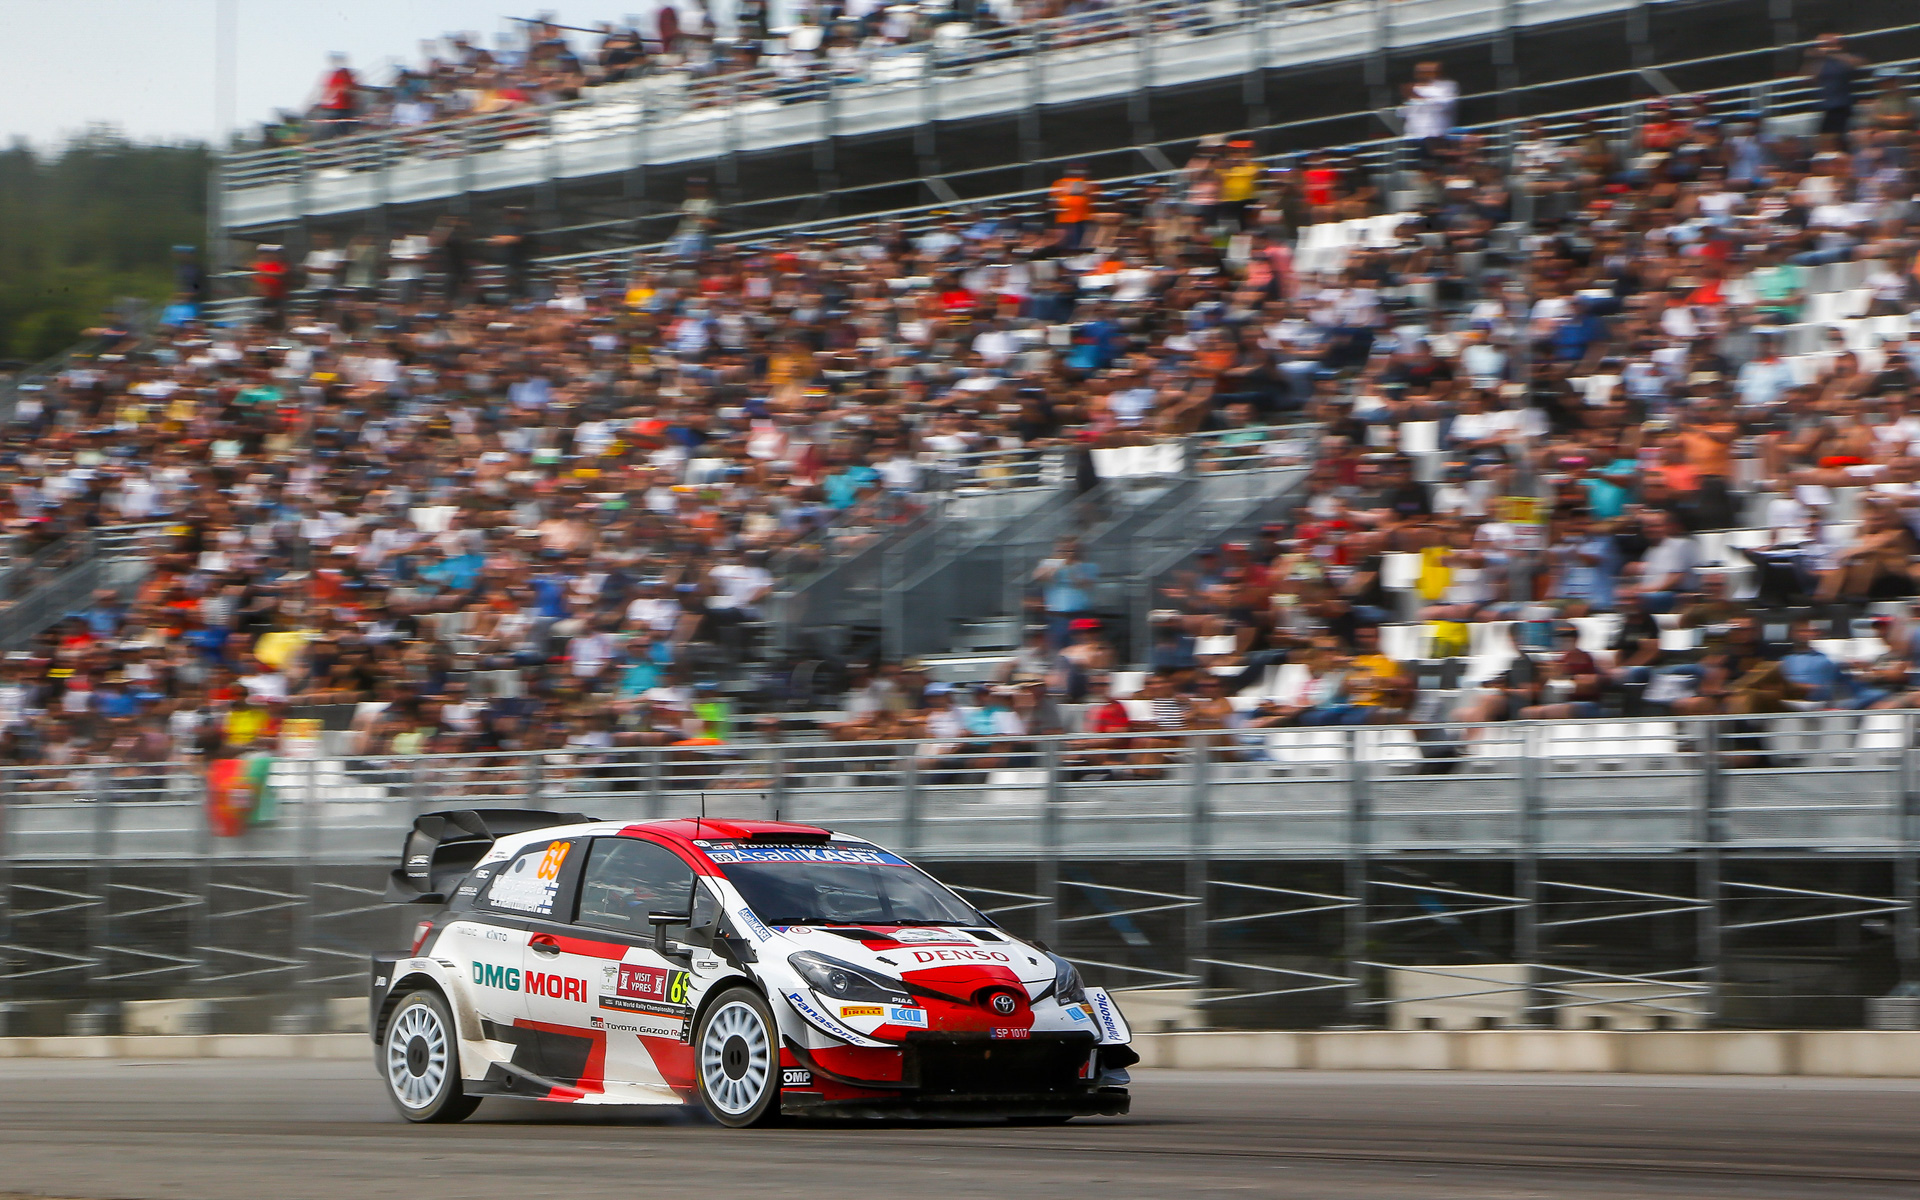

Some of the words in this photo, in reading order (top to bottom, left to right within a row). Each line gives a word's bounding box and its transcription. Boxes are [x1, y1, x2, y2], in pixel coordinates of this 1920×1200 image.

[838, 845, 878, 853] Racing
[537, 841, 571, 880] 69
[713, 854, 733, 862] 69
[734, 849, 886, 864] AsahiKASEI
[912, 950, 1010, 963] DENSO
[472, 961, 520, 991] DMG
[525, 971, 588, 1003] MORI
[634, 972, 651, 983] VISIT
[631, 982, 652, 993] YPRES
[635, 1002, 647, 1011] Rally
[647, 1004, 675, 1014] Championship
[843, 1007, 881, 1015] PIRELLI
[788, 993, 866, 1045] Panasonic
[1094, 993, 1123, 1041] Panasonic
[605, 1022, 638, 1032] TOYOTA
[639, 1026, 669, 1036] GAZOO
[996, 1028, 1009, 1038] SP
[1011, 1028, 1028, 1038] 1017
[783, 1072, 811, 1082] OMP
